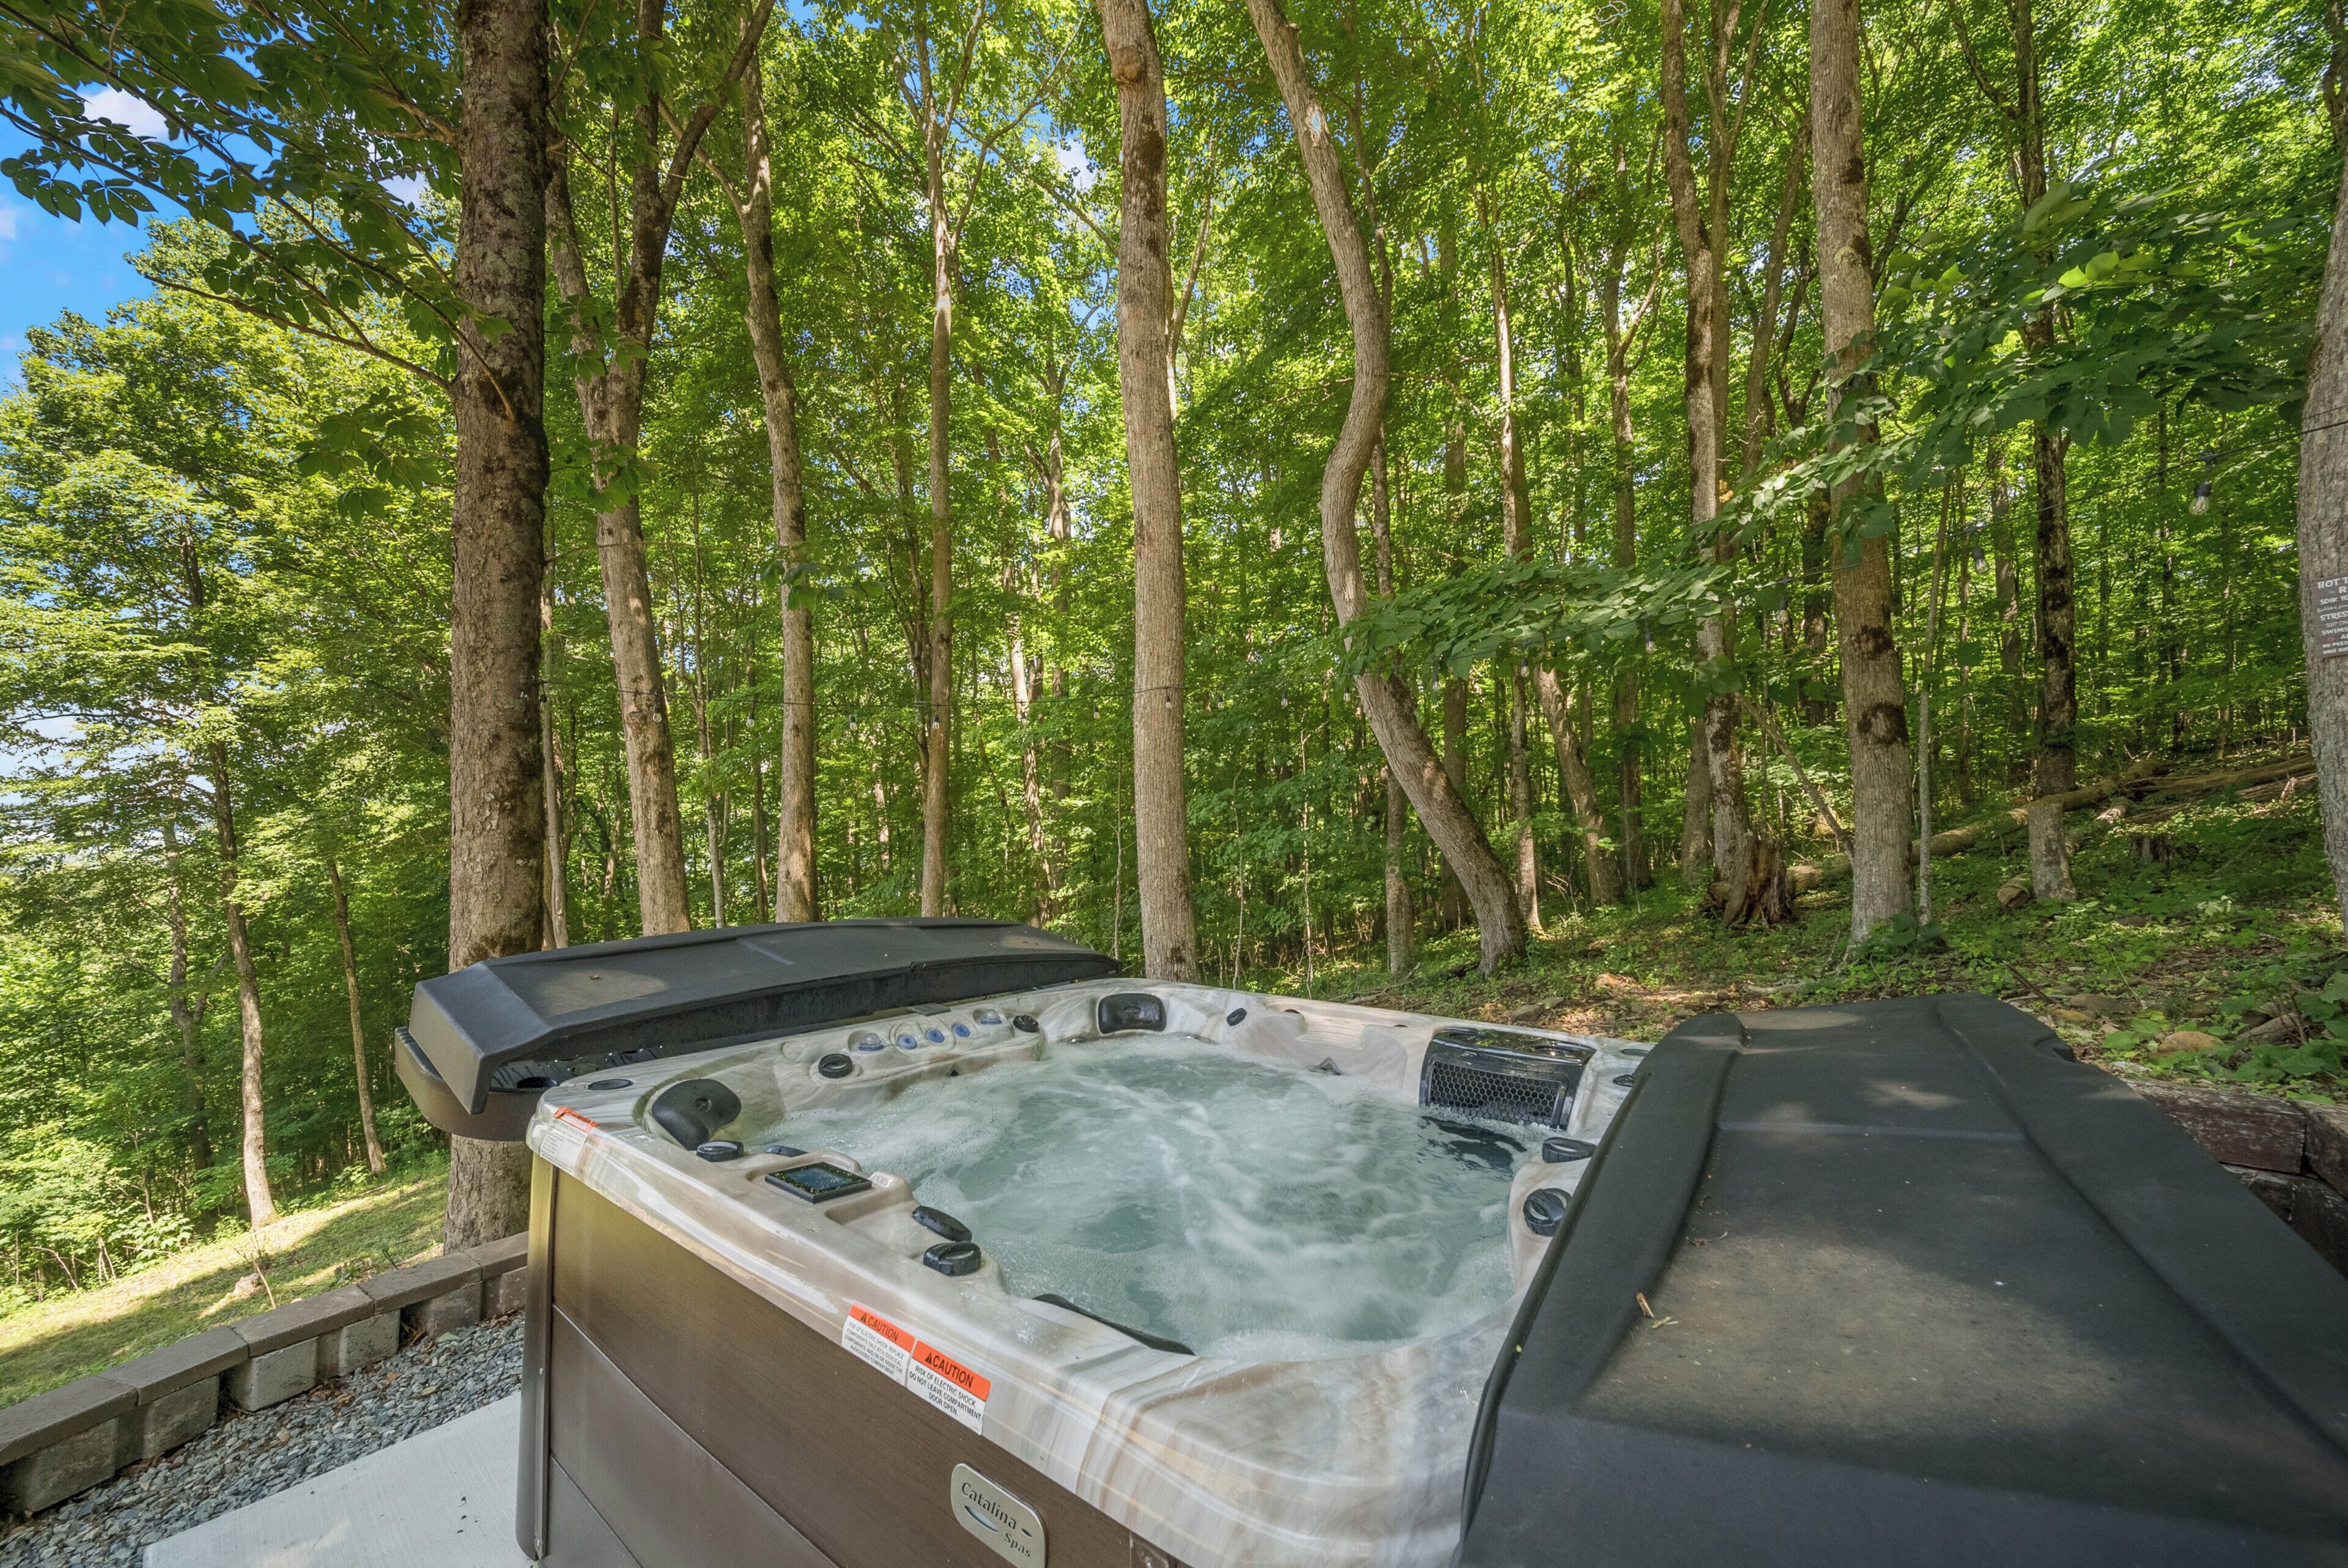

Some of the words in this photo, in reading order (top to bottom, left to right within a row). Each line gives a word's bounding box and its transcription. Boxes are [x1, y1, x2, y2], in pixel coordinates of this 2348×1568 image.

[2317, 578, 2340, 589] HOT
[868, 1317, 899, 1341] CAUTION
[915, 1365, 926, 1377] RISK
[927, 1372, 934, 1381] OF
[934, 1377, 957, 1396] ELECTRIC
[932, 1355, 974, 1388] CAUTION
[909, 1371, 916, 1380] DO
[917, 1377, 926, 1386] NOT
[928, 1382, 942, 1397] LEAVE
[943, 1391, 981, 1421] COMPARTMENT
[929, 1393, 942, 1406] DOOR
[962, 1482, 1017, 1530] Catalina
[1003, 1533, 1032, 1558] Spas
